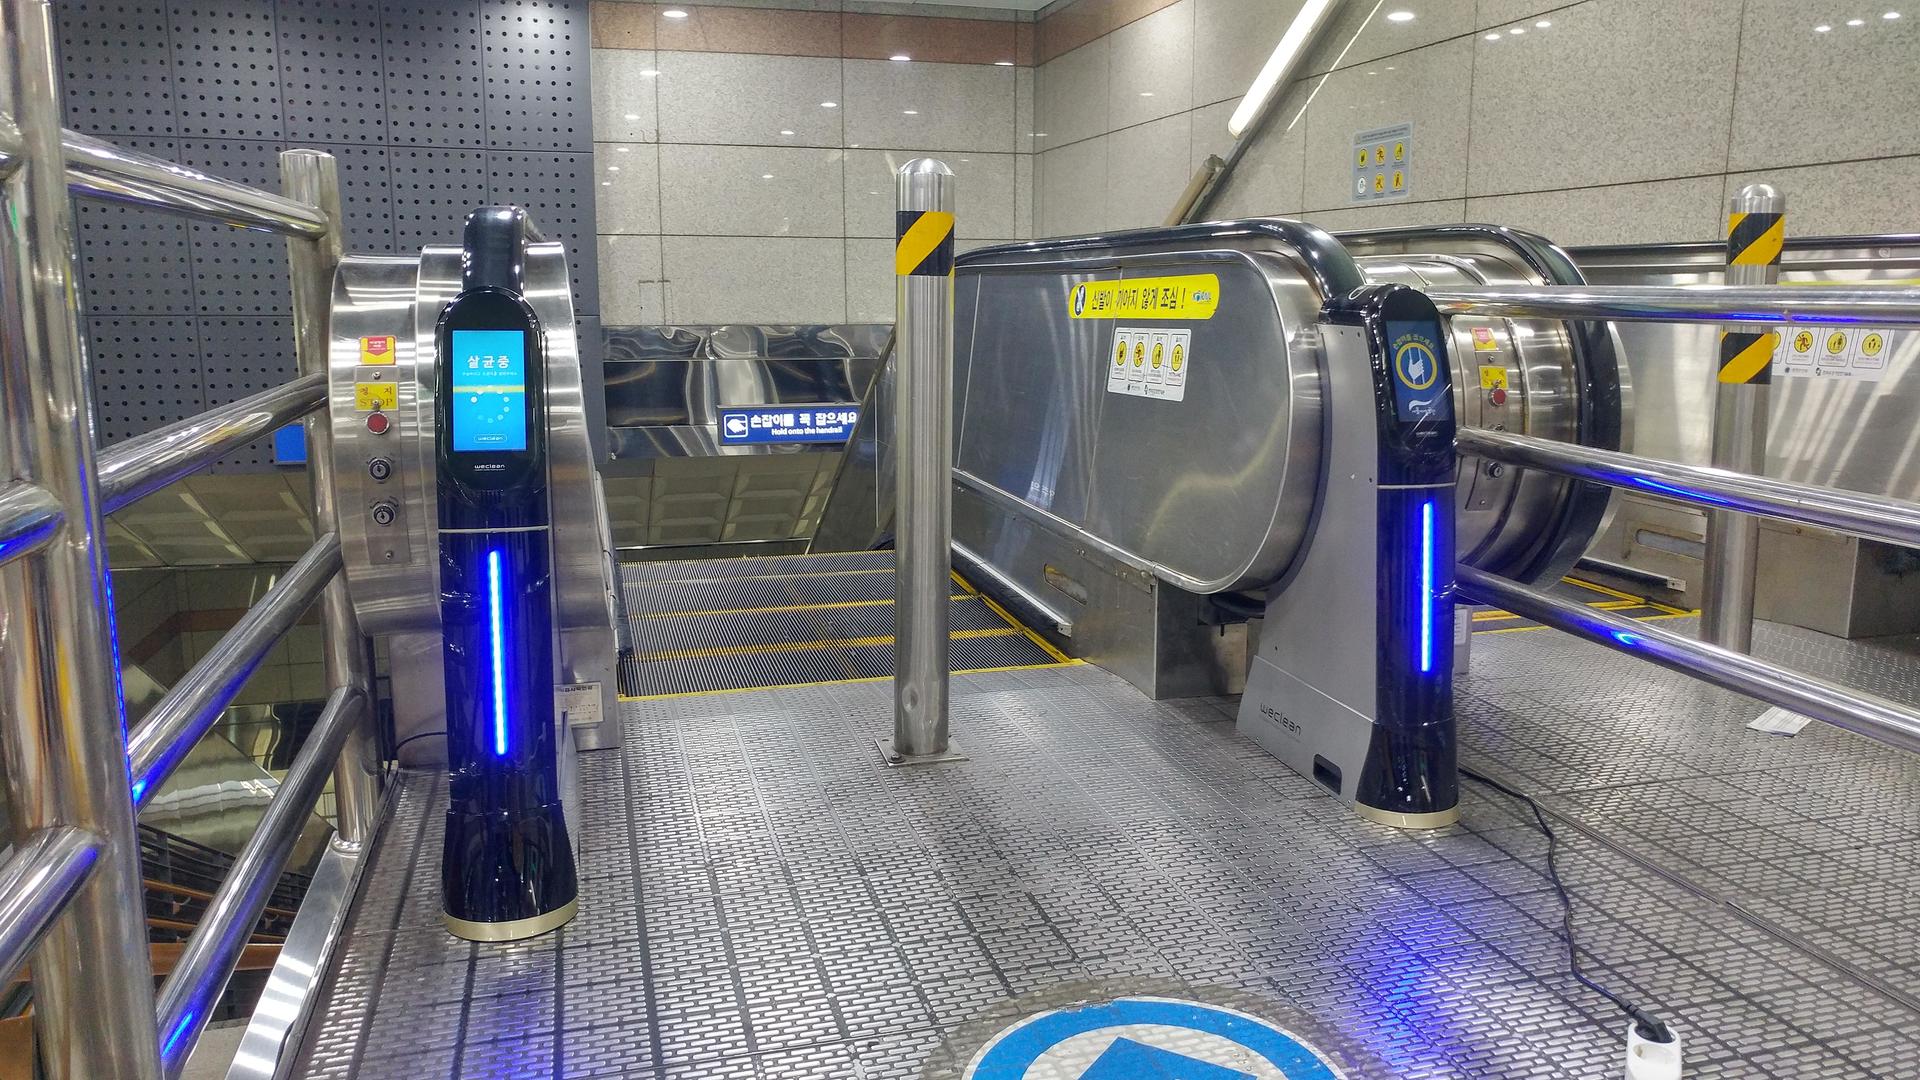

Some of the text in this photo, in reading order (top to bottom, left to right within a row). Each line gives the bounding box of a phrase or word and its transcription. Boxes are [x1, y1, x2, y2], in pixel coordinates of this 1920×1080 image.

[1091, 288, 1114, 310] 신발이
[1141, 287, 1158, 310] 않게
[1160, 286, 1178, 310] 조심
[467, 355, 510, 369] 살균중
[750, 413, 794, 428] 손잡이를
[815, 411, 857, 426] 잡으세요
[771, 427, 788, 436] Hold
[788, 427, 804, 435] onto
[816, 425, 843, 434] handrail
[1259, 702, 1302, 736] weclean
